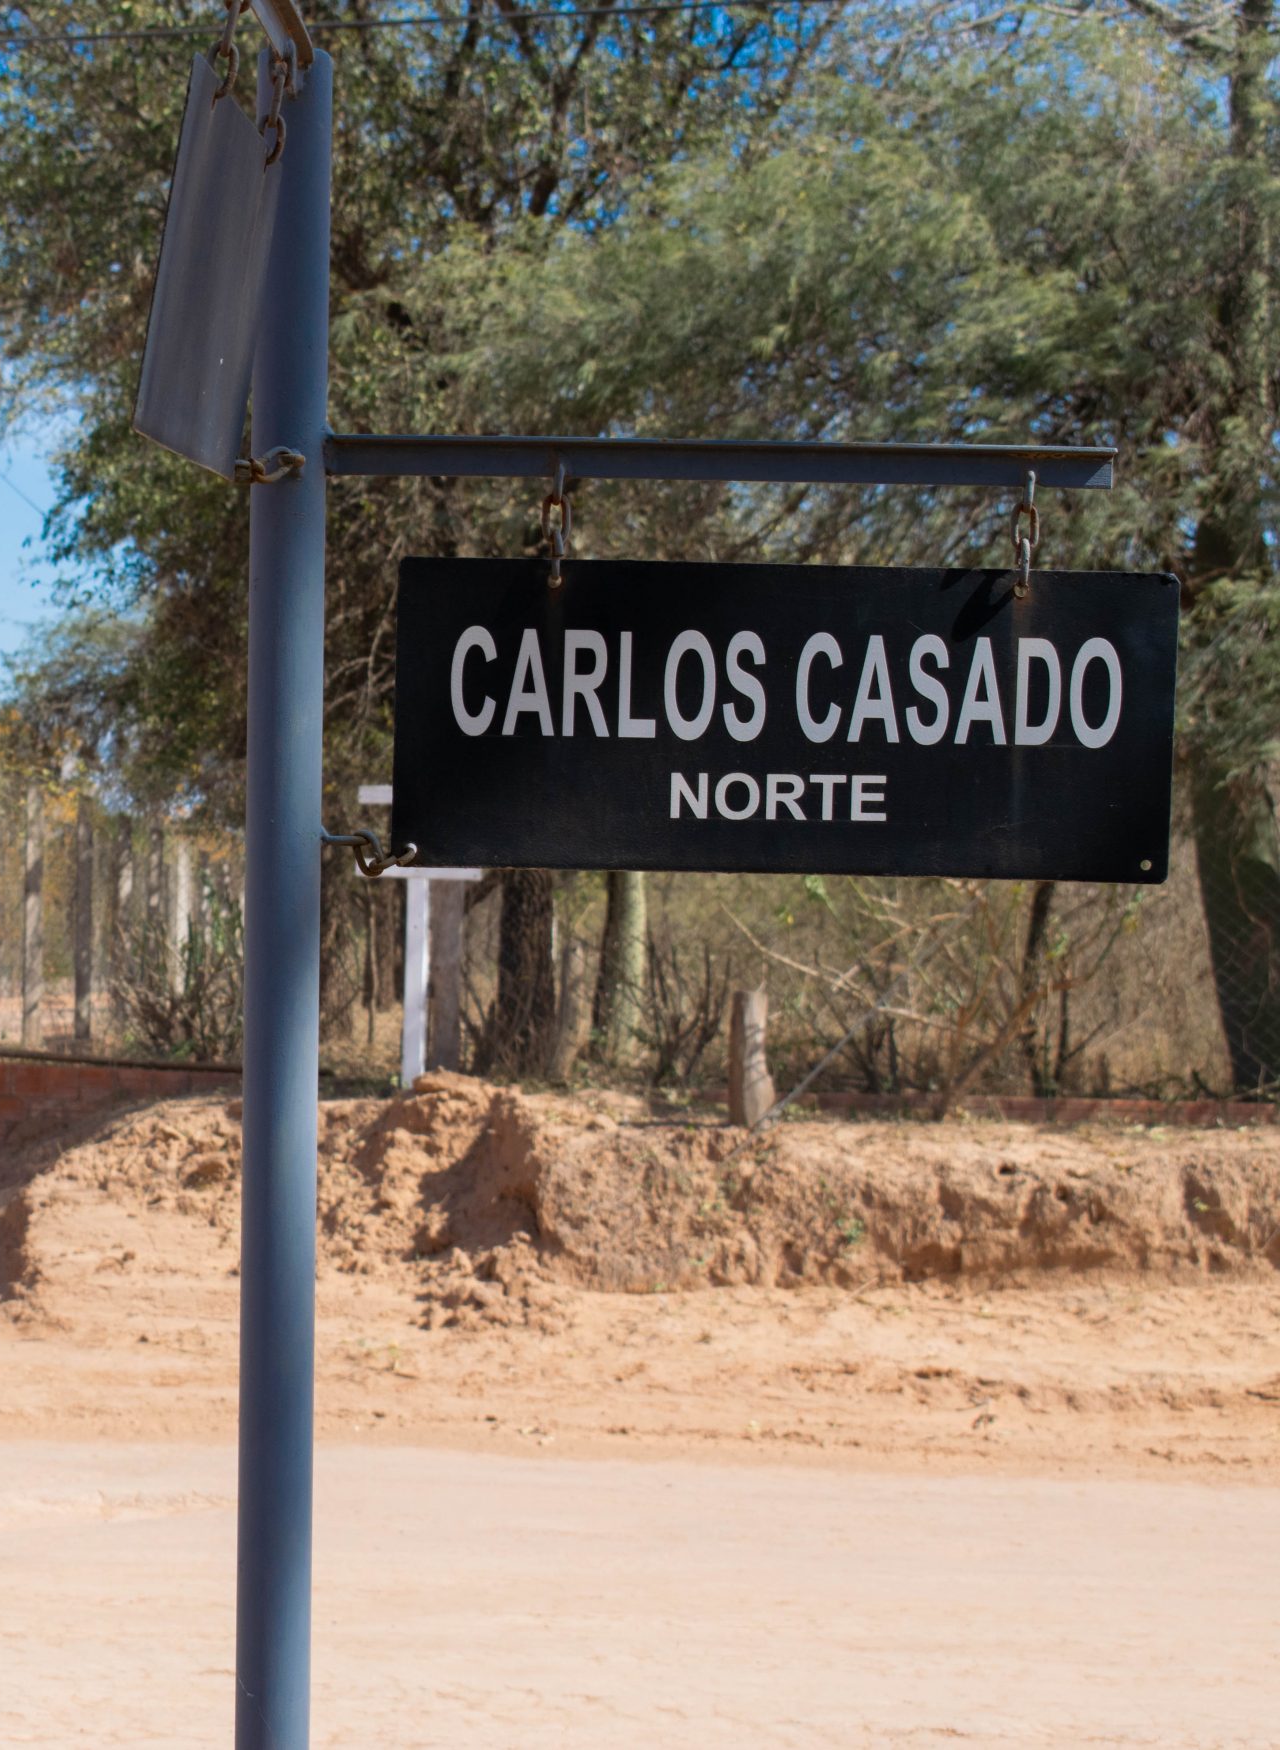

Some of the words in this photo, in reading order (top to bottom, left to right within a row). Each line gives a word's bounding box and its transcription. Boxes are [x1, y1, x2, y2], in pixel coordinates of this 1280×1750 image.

[450, 625, 766, 742] CARLOS
[796, 632, 1122, 749] CASADO
[670, 772, 887, 822] NORTE
